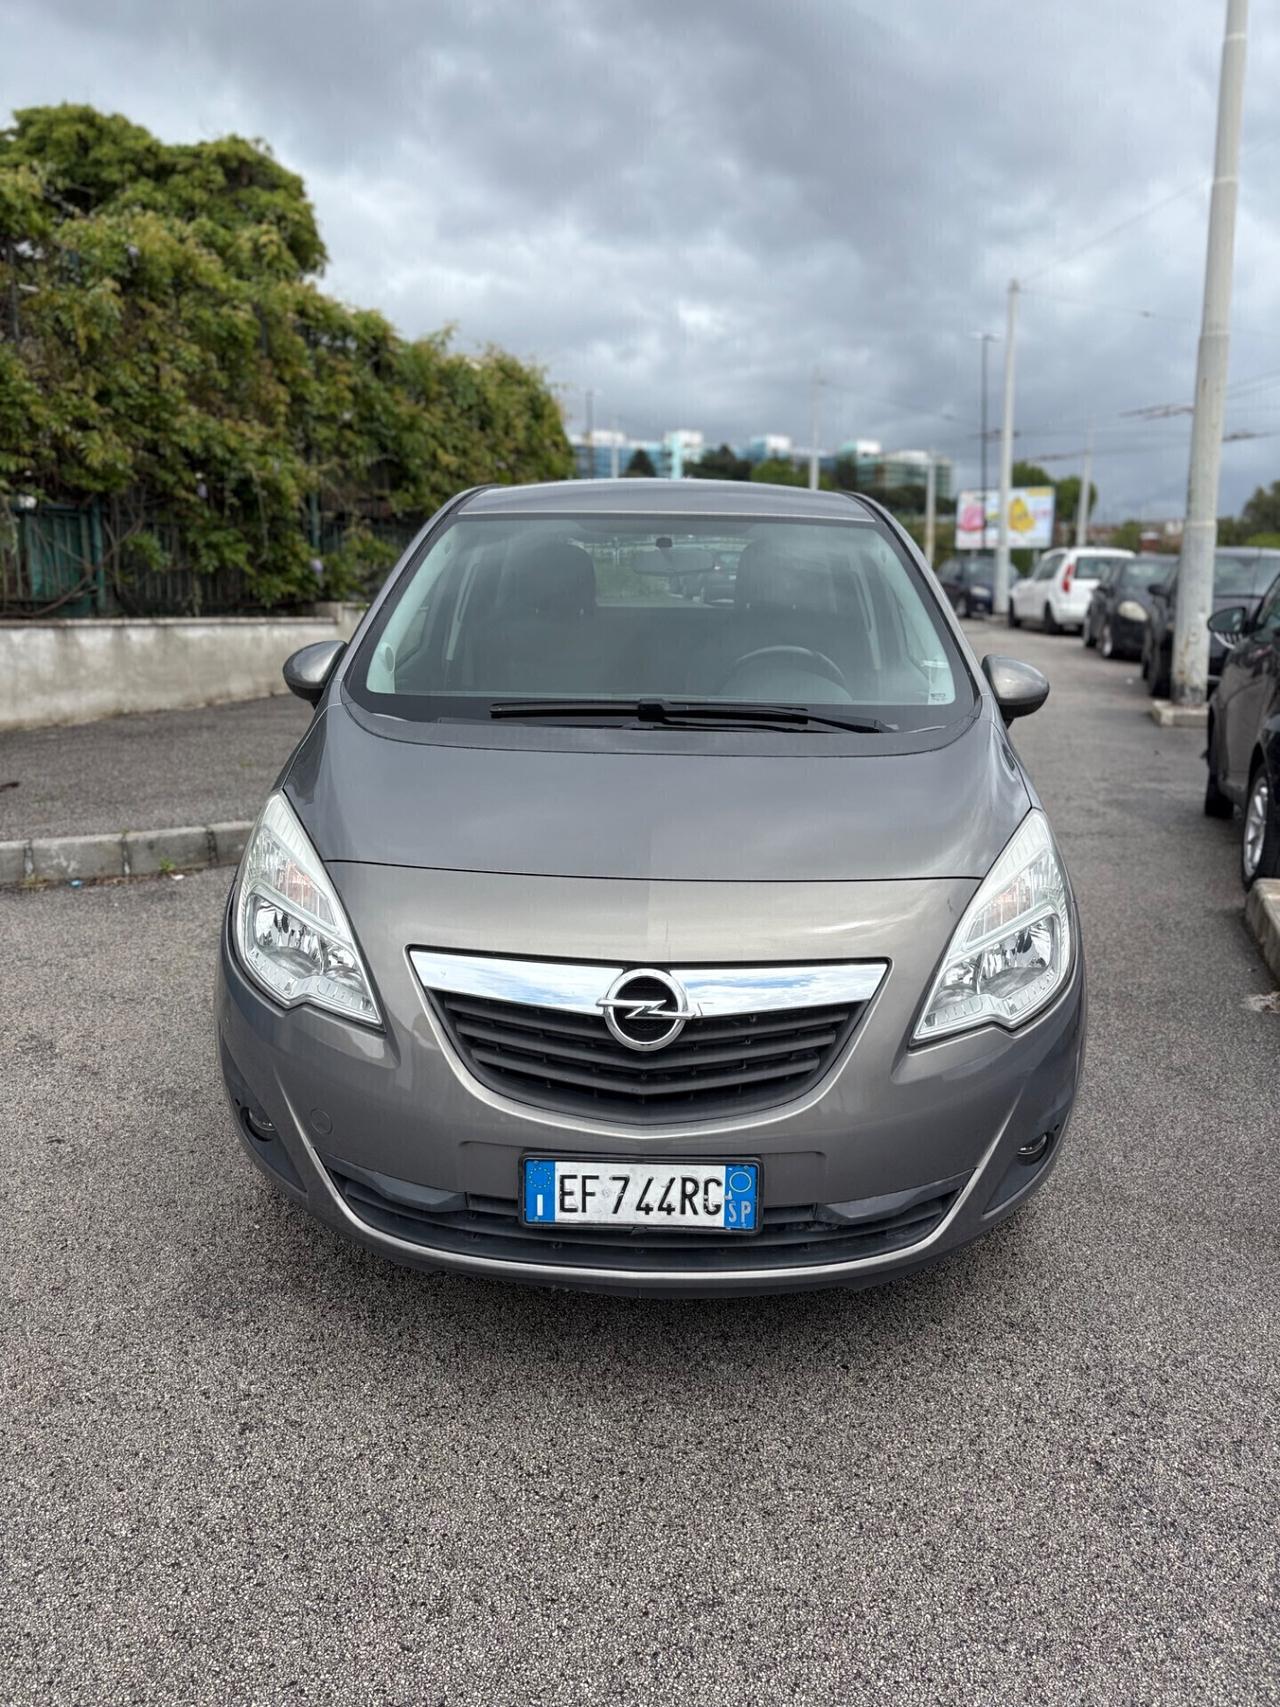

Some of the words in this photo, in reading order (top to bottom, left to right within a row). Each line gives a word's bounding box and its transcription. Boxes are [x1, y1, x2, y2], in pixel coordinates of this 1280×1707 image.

[536, 1194, 544, 1216] I
[559, 1174, 599, 1213] EF
[609, 1176, 722, 1216] 744RG
[728, 1200, 752, 1223] SP
